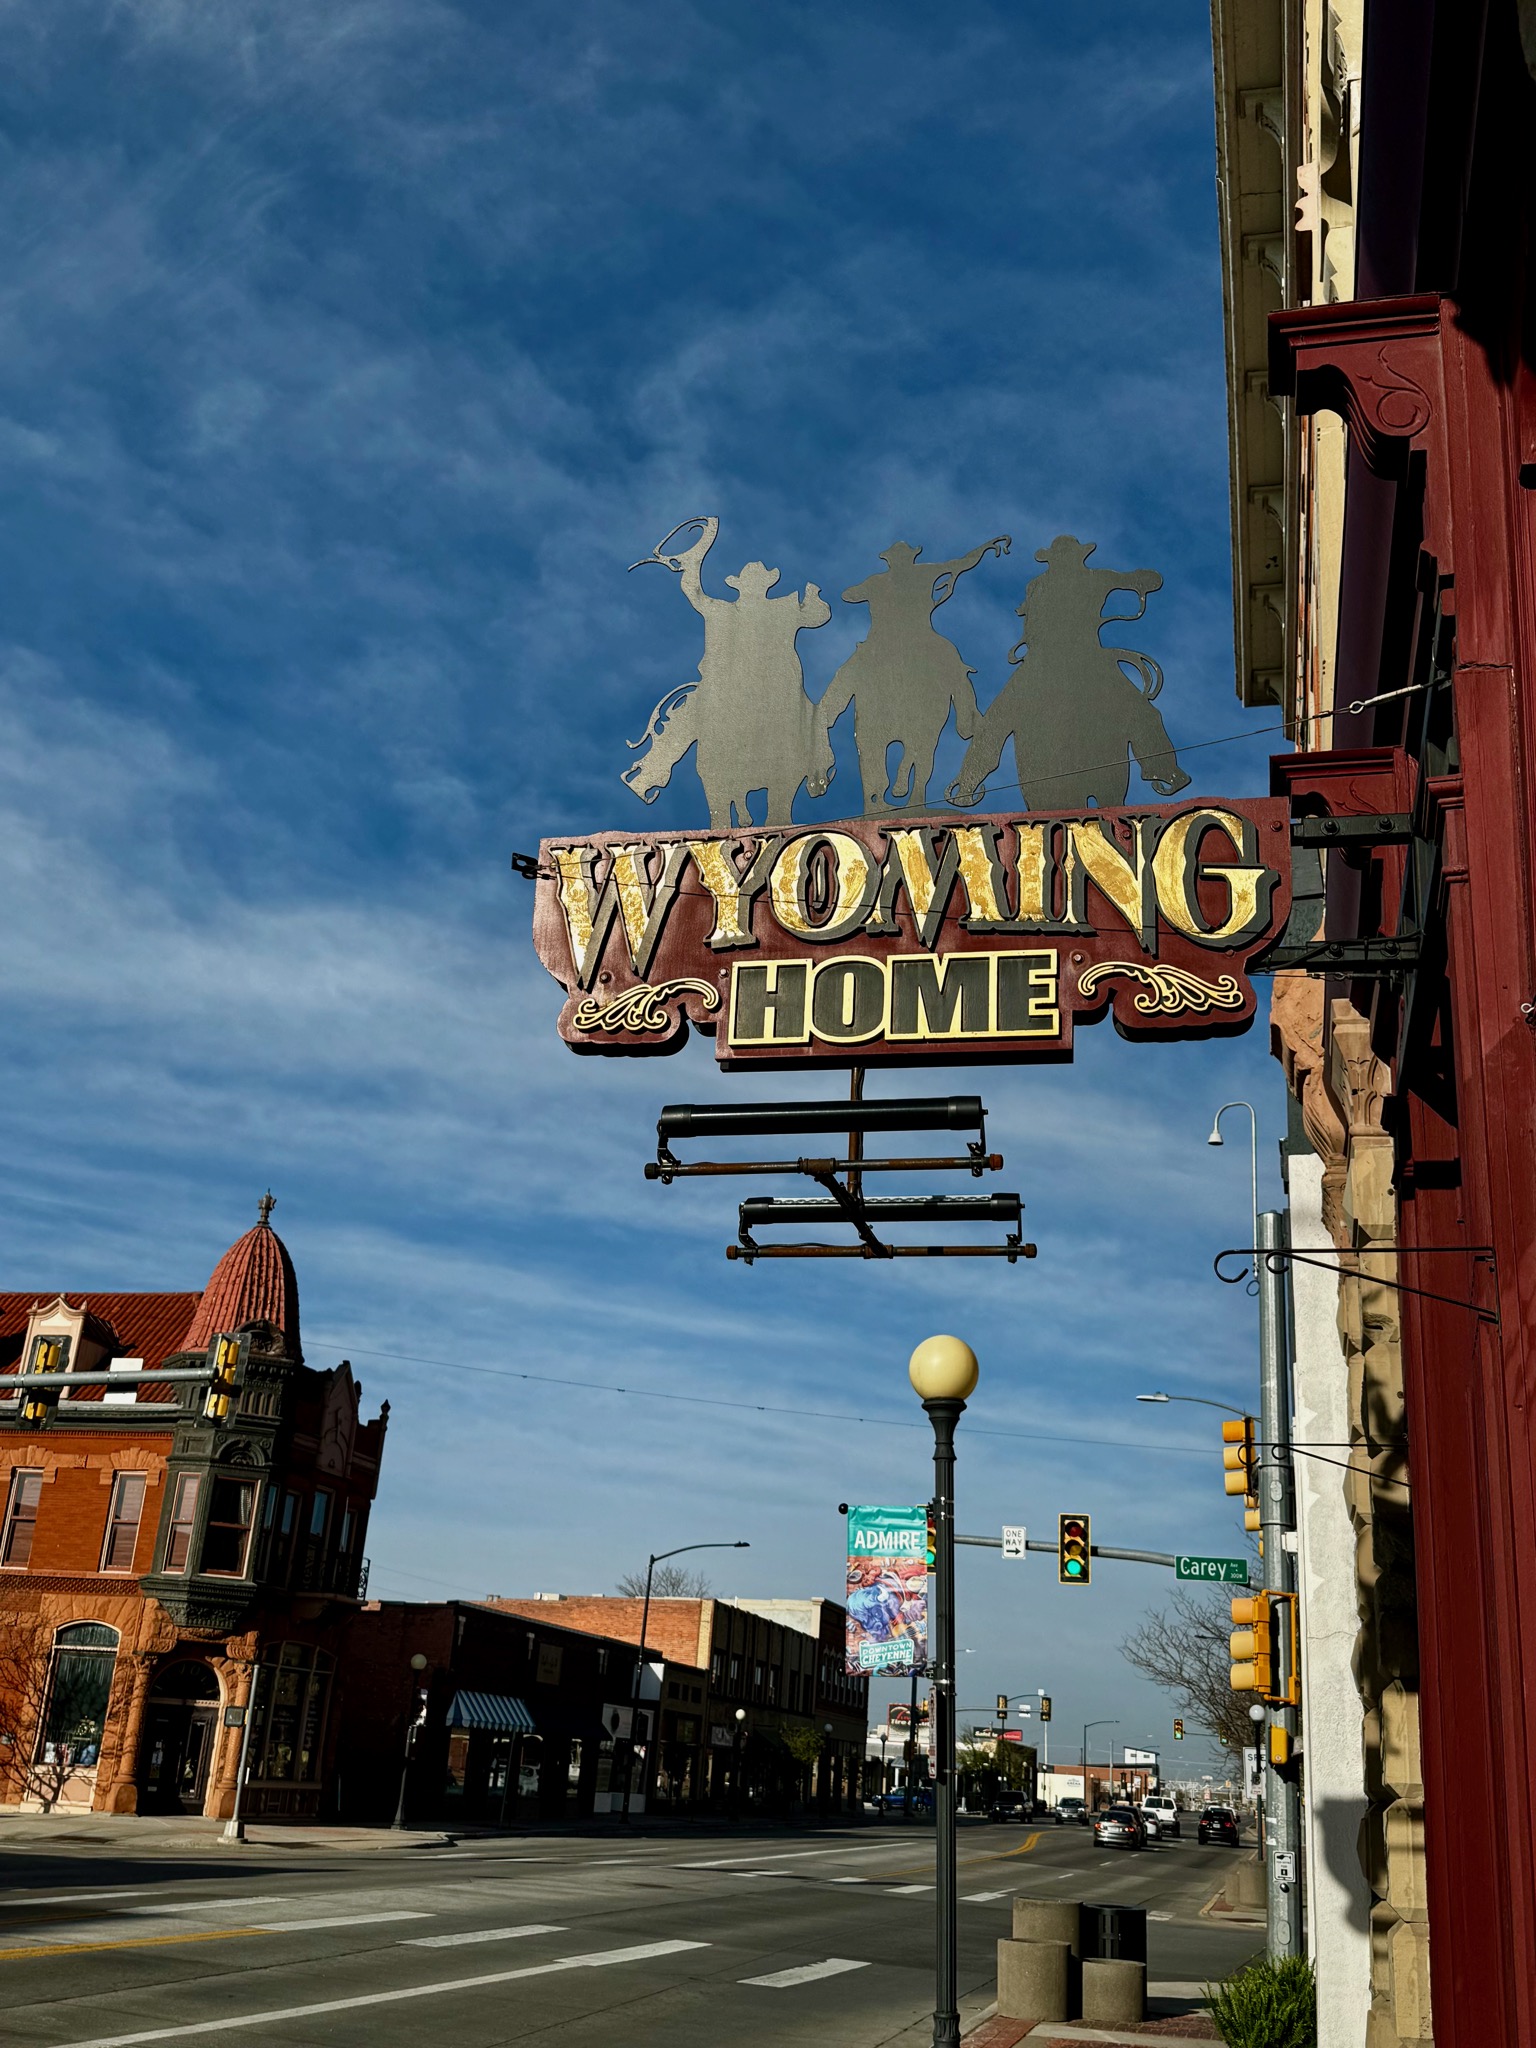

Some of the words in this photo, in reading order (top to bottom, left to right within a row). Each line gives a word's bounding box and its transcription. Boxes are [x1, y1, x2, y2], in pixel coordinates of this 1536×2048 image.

[549, 808, 1277, 987] WYOMING
[729, 950, 1060, 1047] HOME
[854, 1529, 921, 1550] ADMIRE
[1005, 1529, 1022, 1538] ONE
[1005, 1538, 1022, 1546] WAY
[1180, 1556, 1227, 1580] Carey
[862, 1641, 912, 1655] DOWNTOWN
[862, 1649, 912, 1665] CHEYENNE
